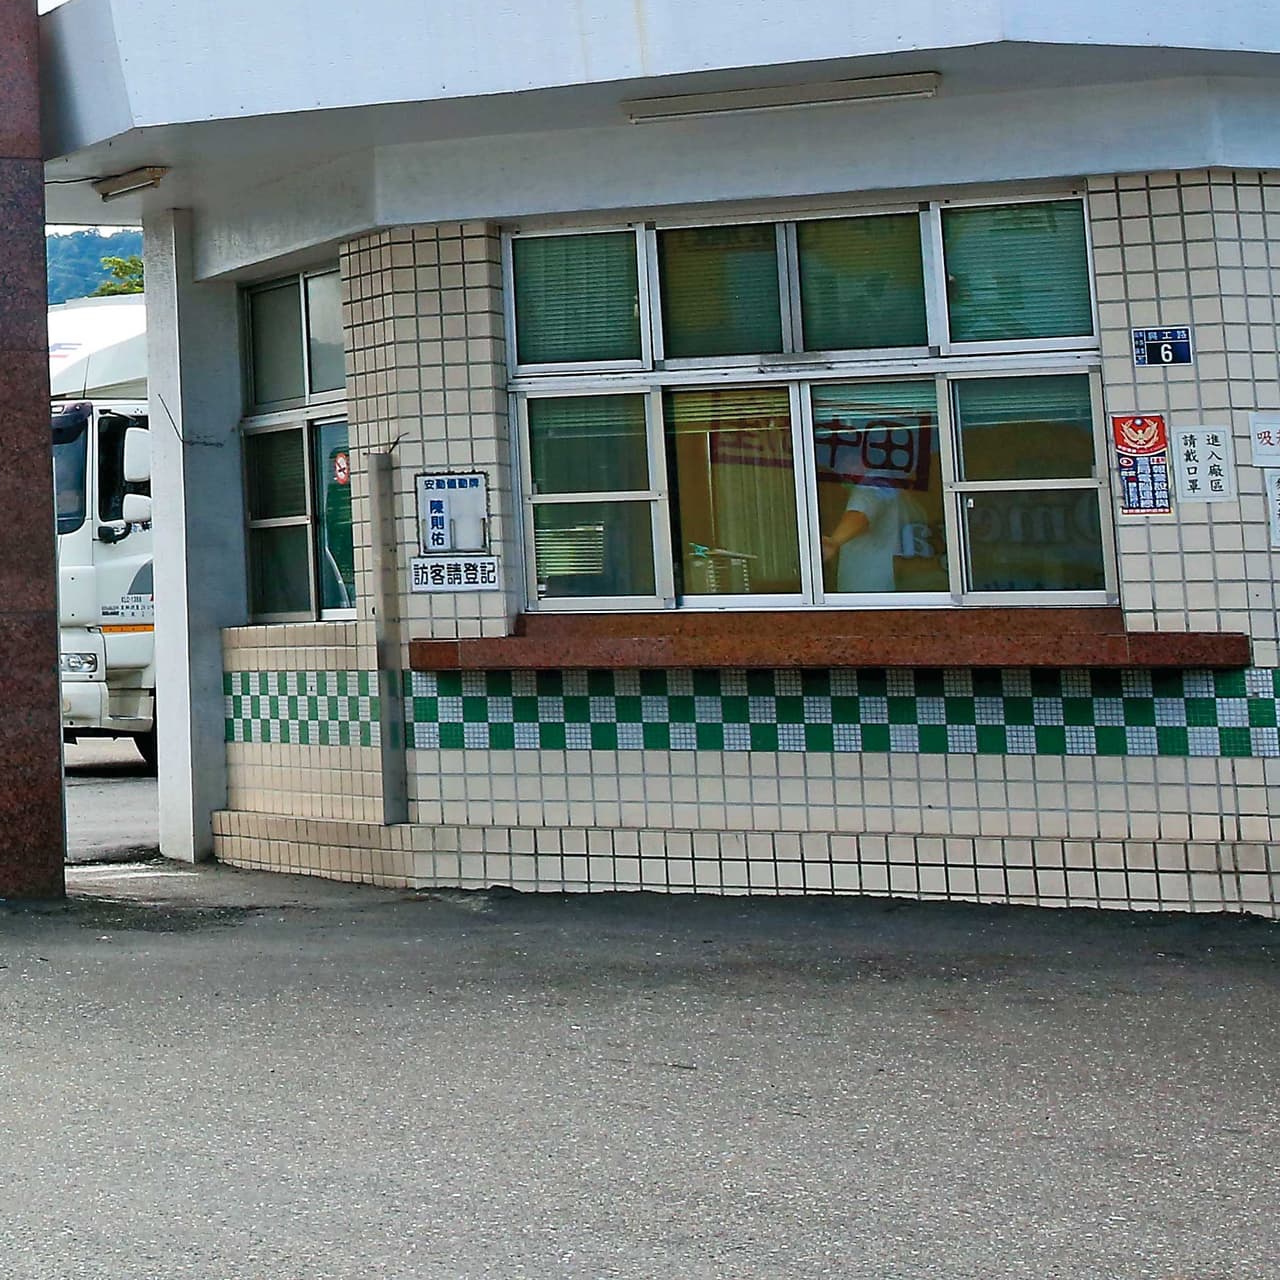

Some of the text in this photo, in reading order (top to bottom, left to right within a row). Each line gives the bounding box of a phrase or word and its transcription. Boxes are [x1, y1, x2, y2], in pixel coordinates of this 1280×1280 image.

[1160, 343, 1173, 363] 6
[1256, 429, 1280, 447] 吸
[1182, 434, 1200, 493] 請戴口罩
[1206, 434, 1224, 492] 進入廠區
[429, 499, 445, 546] 陳則佑
[413, 562, 497, 585] 訪客請登記
